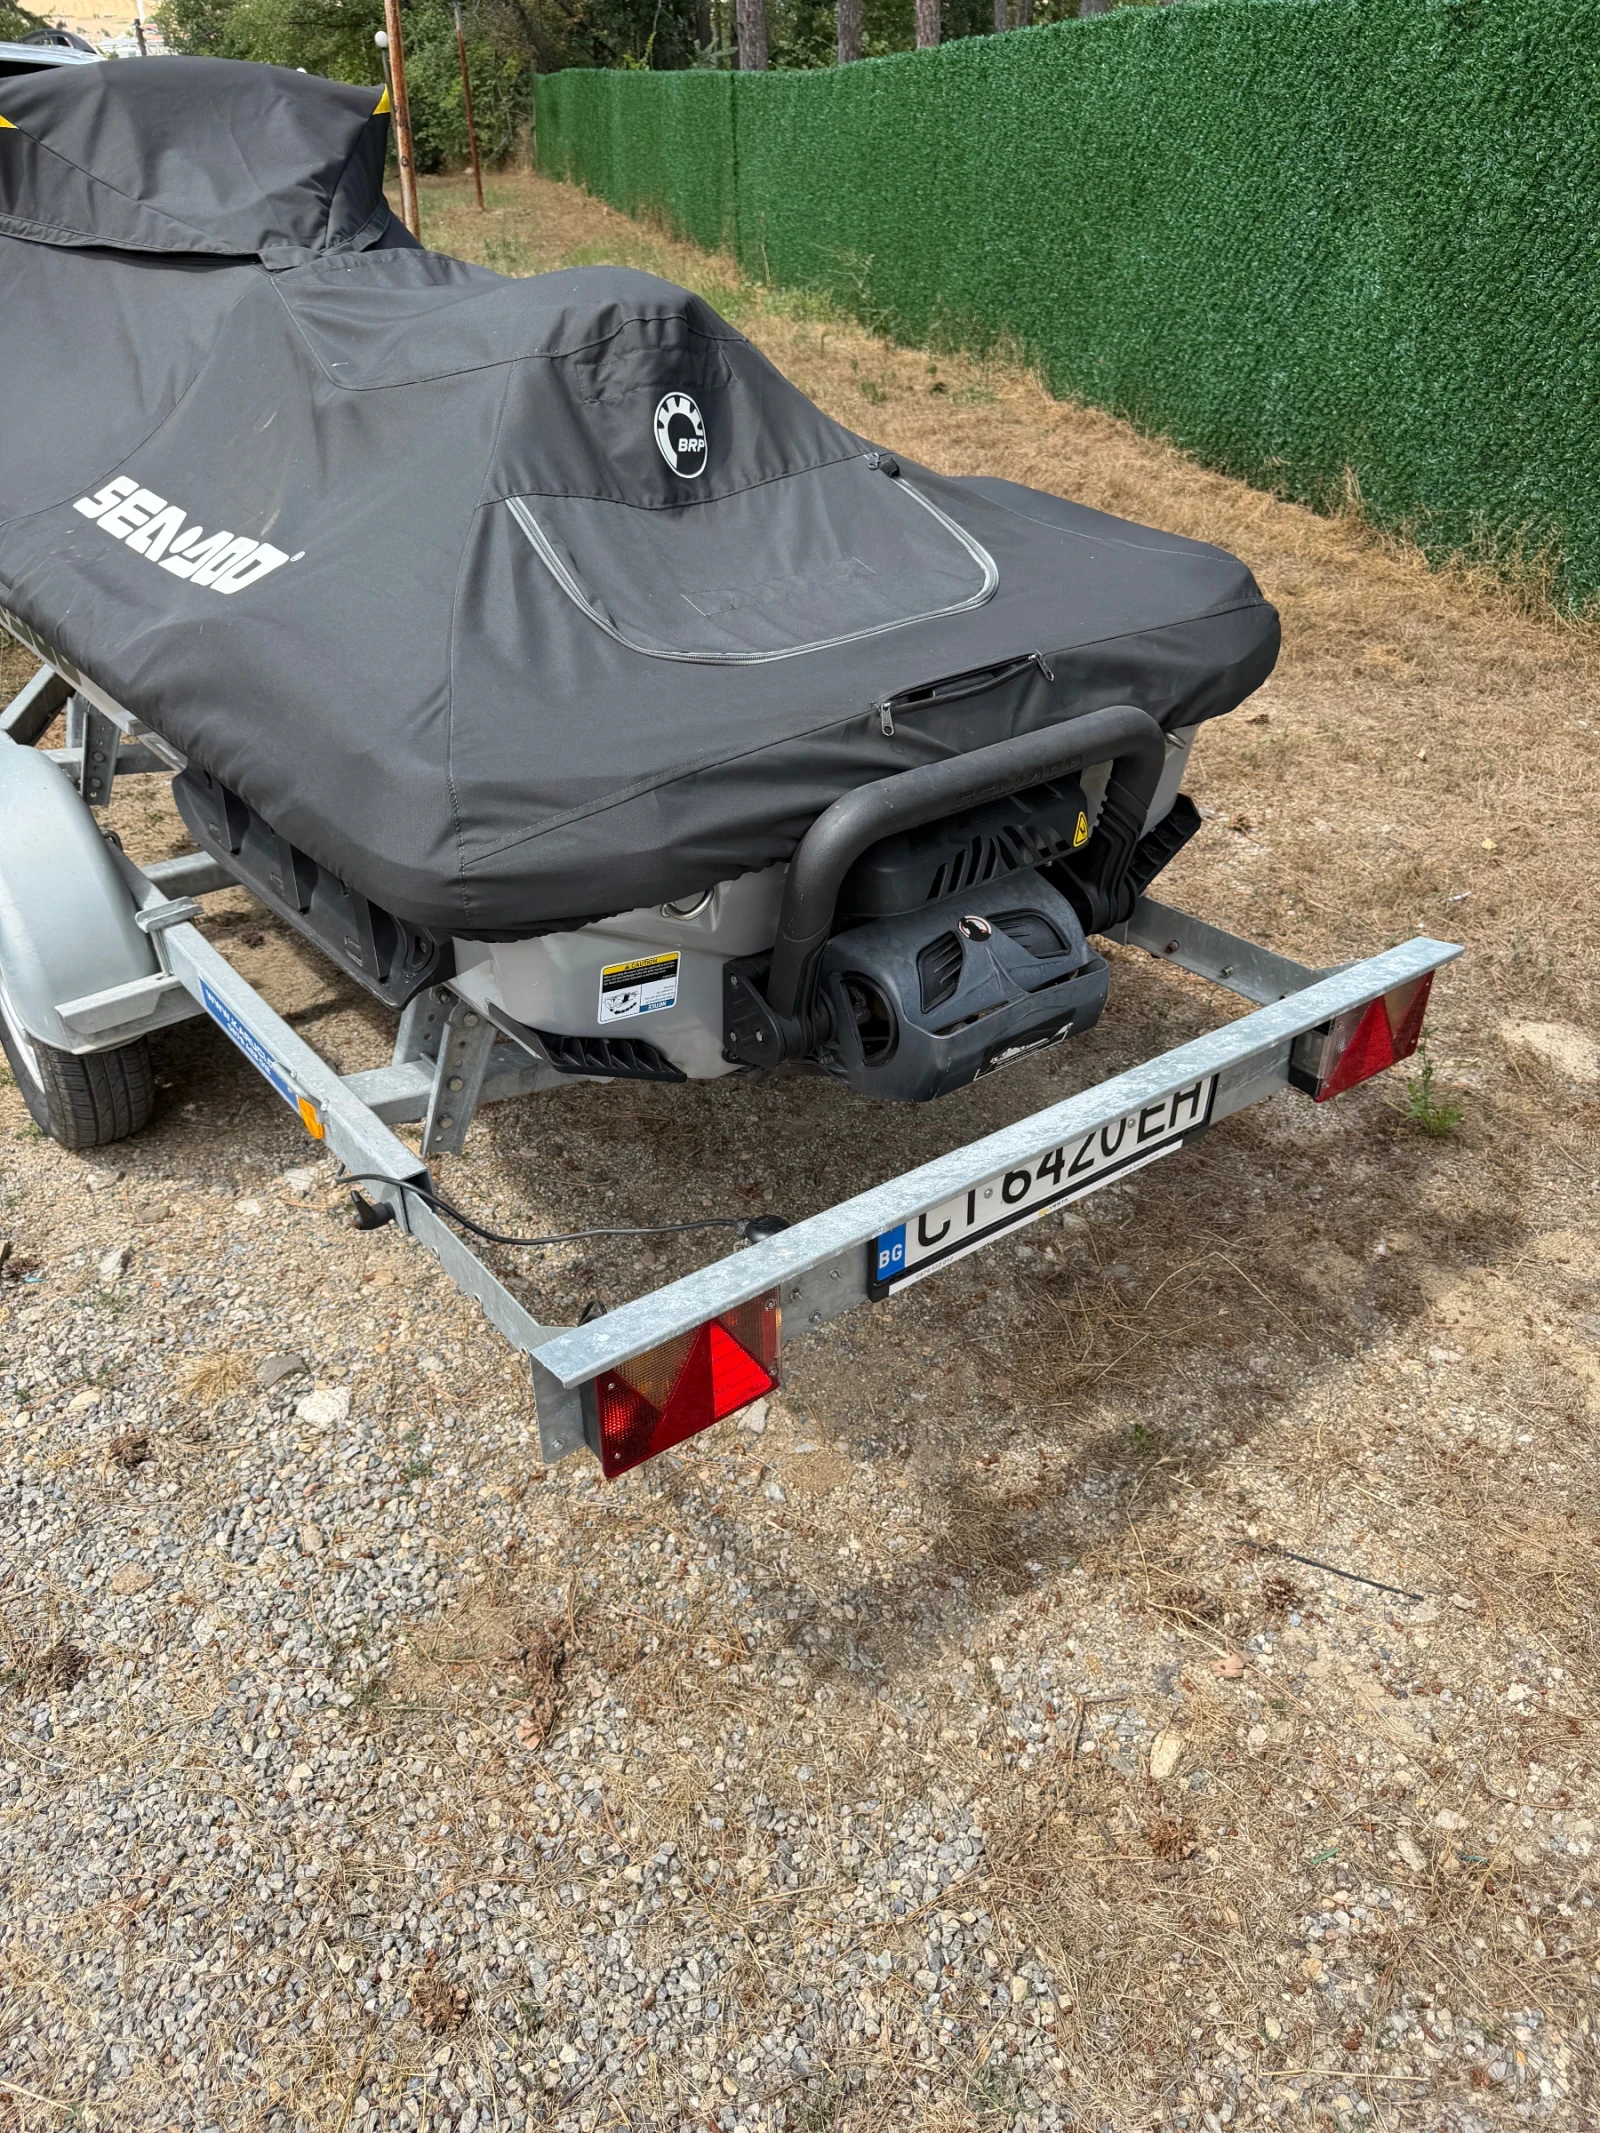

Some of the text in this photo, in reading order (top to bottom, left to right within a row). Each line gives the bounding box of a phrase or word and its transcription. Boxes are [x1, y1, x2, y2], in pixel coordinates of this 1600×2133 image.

[678, 438, 705, 453] BRP
[631, 957, 658, 969] CAUTION
[879, 1243, 903, 1270] BG
[1002, 1117, 1127, 1204] 6420
[1136, 1081, 1203, 1144] EH
